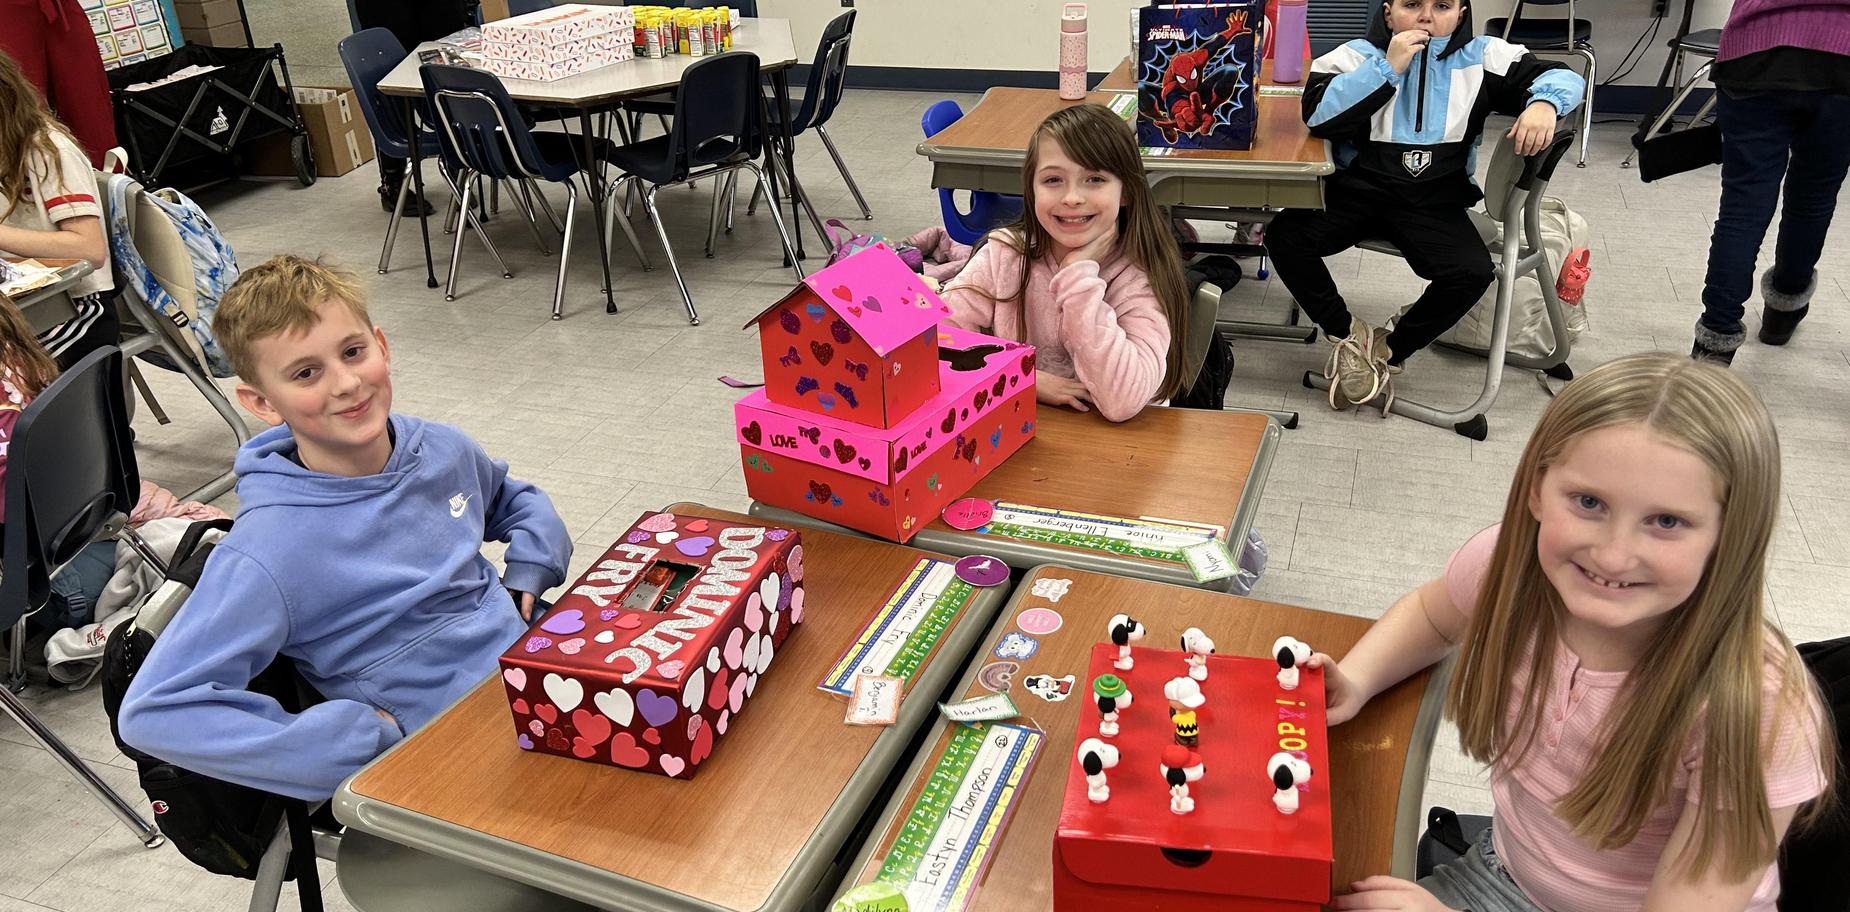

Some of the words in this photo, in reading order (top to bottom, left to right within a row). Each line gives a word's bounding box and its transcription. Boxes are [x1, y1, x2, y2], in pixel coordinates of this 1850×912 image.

[770, 434, 798, 448] LOVE
[910, 441, 927, 459] LOVE
[449, 492, 465, 510] NIKE
[1033, 517, 1108, 536] Ellenberger
[571, 543, 660, 607] FRY
[604, 527, 766, 684] DOMINIC
[902, 592, 937, 621] Dominic
[881, 630, 911, 645] Fry
[868, 681, 887, 716] Benjamin
[953, 704, 998, 717] Harlan
[914, 837, 957, 887] Eastyn
[948, 767, 992, 820] Thompson
